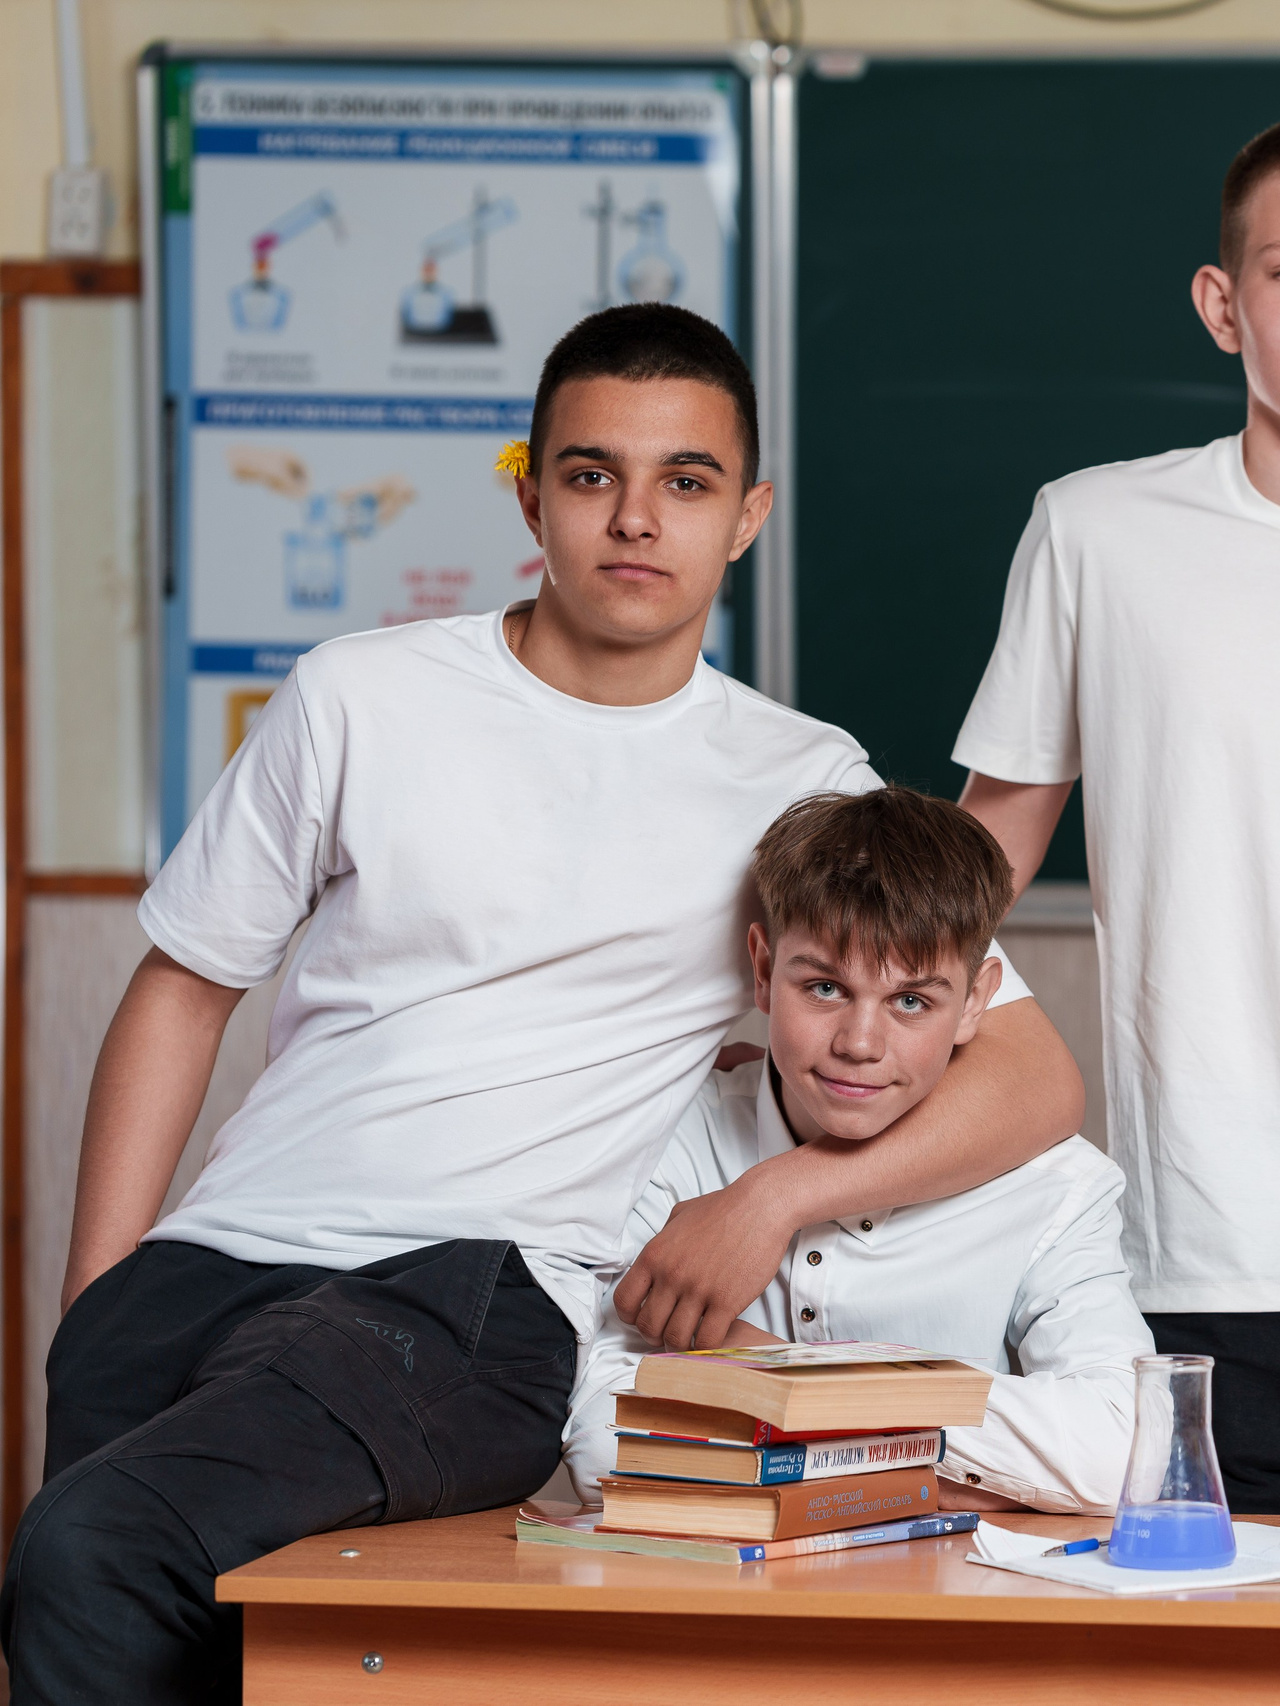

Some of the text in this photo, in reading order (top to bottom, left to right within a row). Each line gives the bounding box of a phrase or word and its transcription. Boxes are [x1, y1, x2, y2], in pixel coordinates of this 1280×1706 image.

[810, 1438, 937, 1470] АНГЛИЙСКИЙ ЯЗЫК ЭКСПРЕСС-КУРС
[767, 1463, 795, 1475] Петрова
[807, 1488, 864, 1510] АНГЛО-РУССКИЙ
[882, 1494, 912, 1510] СЛОВАРЬ
[1137, 1529, 1151, 1539] 100
